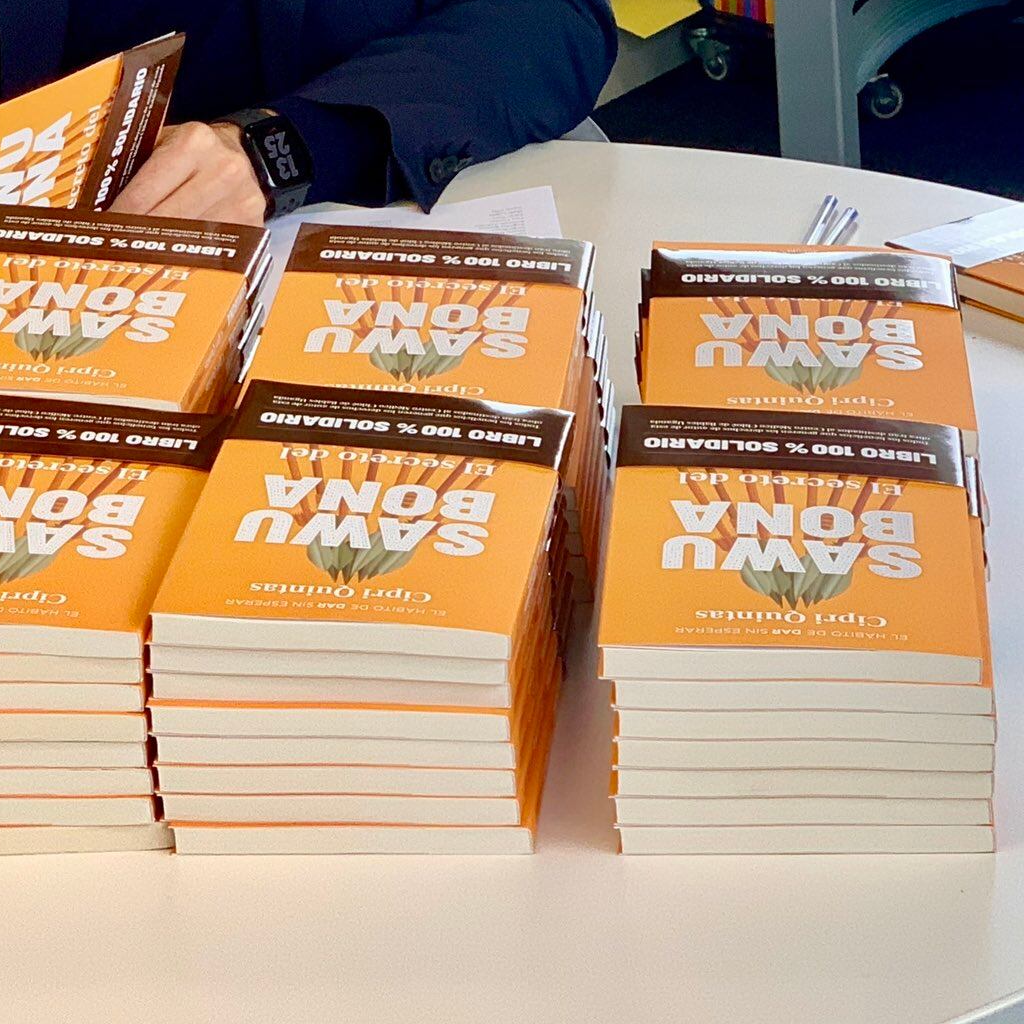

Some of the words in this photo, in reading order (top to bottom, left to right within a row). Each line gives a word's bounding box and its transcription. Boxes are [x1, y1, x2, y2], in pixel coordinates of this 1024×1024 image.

[96, 177, 114, 202] 100
[105, 159, 119, 175] %
[112, 67, 147, 157] SOLIDARIO
[264, 132, 290, 158] 25
[275, 161, 299, 180] 13
[323, 299, 531, 332] BONA
[699, 314, 916, 345] BONA
[303, 326, 529, 359] SAWU
[694, 340, 924, 372] SAWU
[727, 395, 823, 406] Quintas
[831, 396, 895, 408] Cipri
[260, 412, 390, 432] SOLIDARIO
[398, 424, 417, 434] %
[57, 429, 76, 440] %
[80, 431, 120, 443] 100
[421, 425, 461, 438] 100
[468, 428, 542, 447] LIBRO
[125, 434, 198, 450] LIBRO
[643, 437, 778, 453] SOLIDARIO
[787, 443, 808, 454] %
[280, 447, 328, 461] del
[811, 444, 855, 456] 100
[860, 448, 937, 465] LIBRO
[338, 450, 457, 469] secreto
[464, 462, 496, 476] El
[678, 472, 729, 484] del
[739, 473, 865, 490] secreto
[872, 482, 904, 496] El
[264, 474, 496, 523] BONA
[670, 499, 915, 544] BONA
[233, 509, 489, 557] SAWU
[661, 535, 923, 579] SAWU
[249, 582, 353, 598] Quintas
[361, 588, 432, 603] Cipri
[695, 610, 806, 623] Quintas
[815, 612, 887, 627] Cipri
[675, 626, 739, 635] ESPERAR
[746, 626, 768, 635] SIN
[772, 627, 801, 635] DAR
[807, 628, 826, 636] DE
[832, 630, 887, 639] HÁBITO
[892, 632, 908, 641] EL
